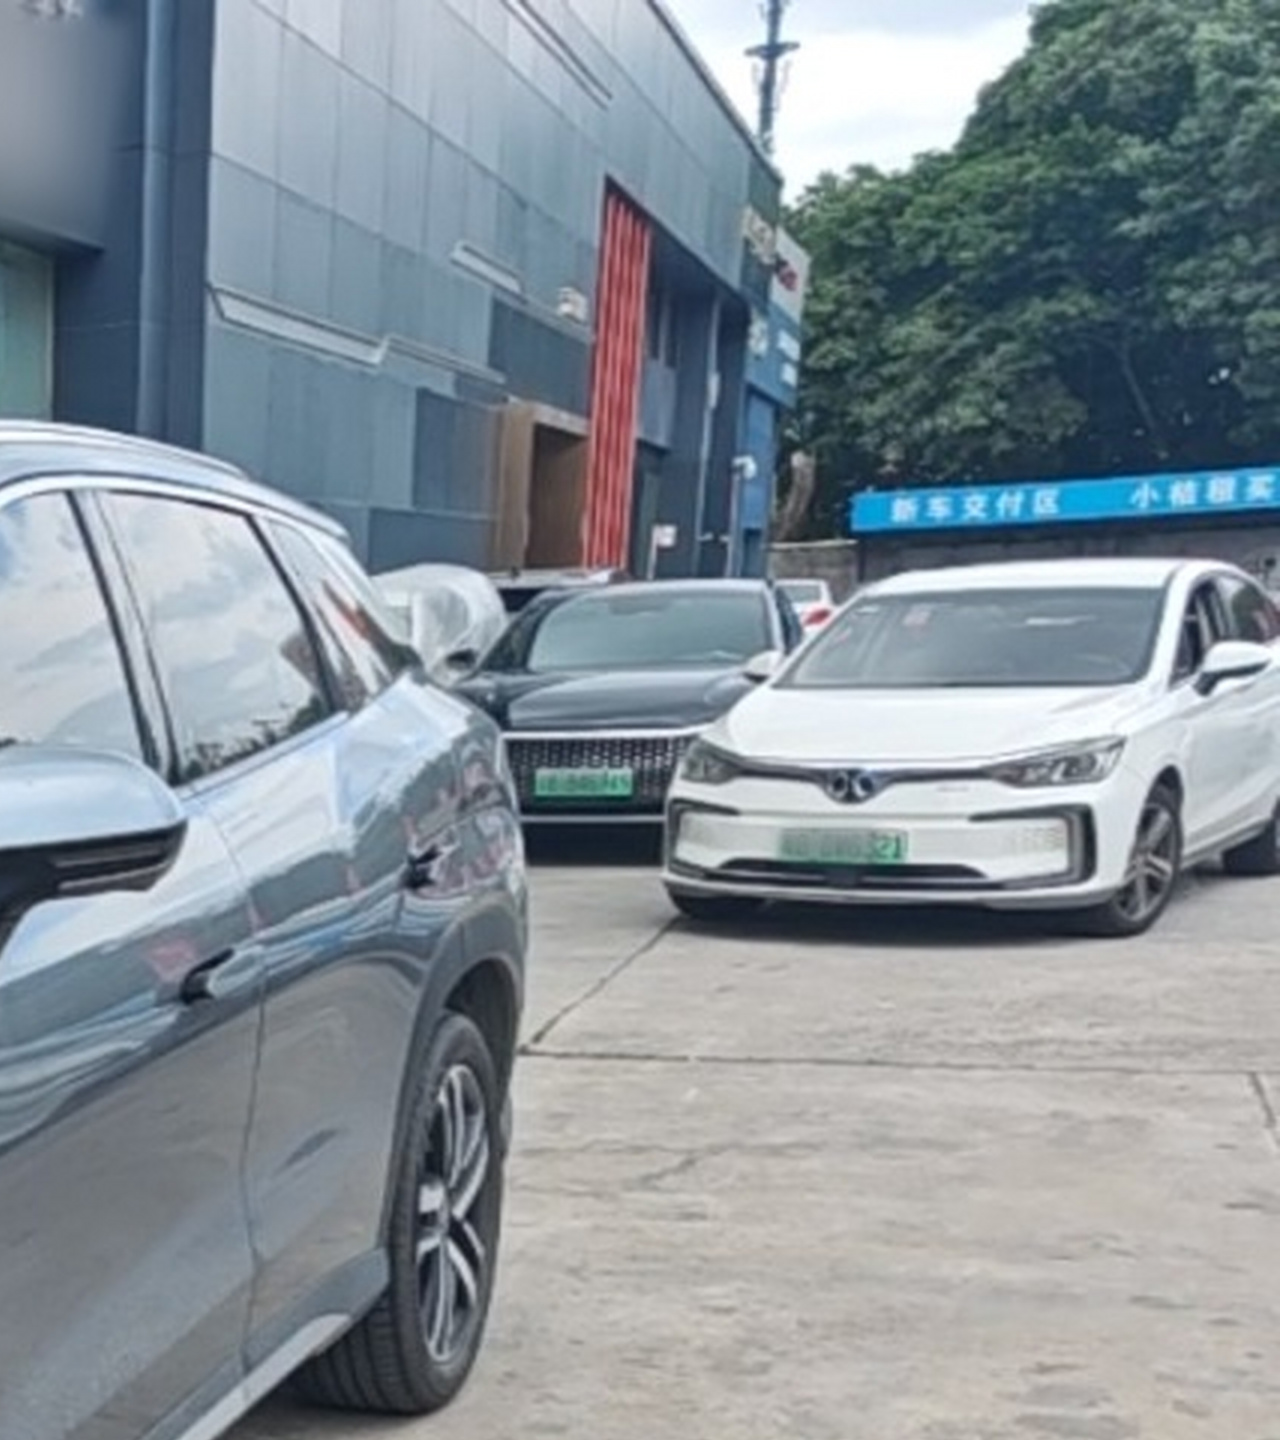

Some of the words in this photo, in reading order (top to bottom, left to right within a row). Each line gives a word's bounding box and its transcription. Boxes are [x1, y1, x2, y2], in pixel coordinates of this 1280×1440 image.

[891, 489, 1061, 522] 新车交付区
